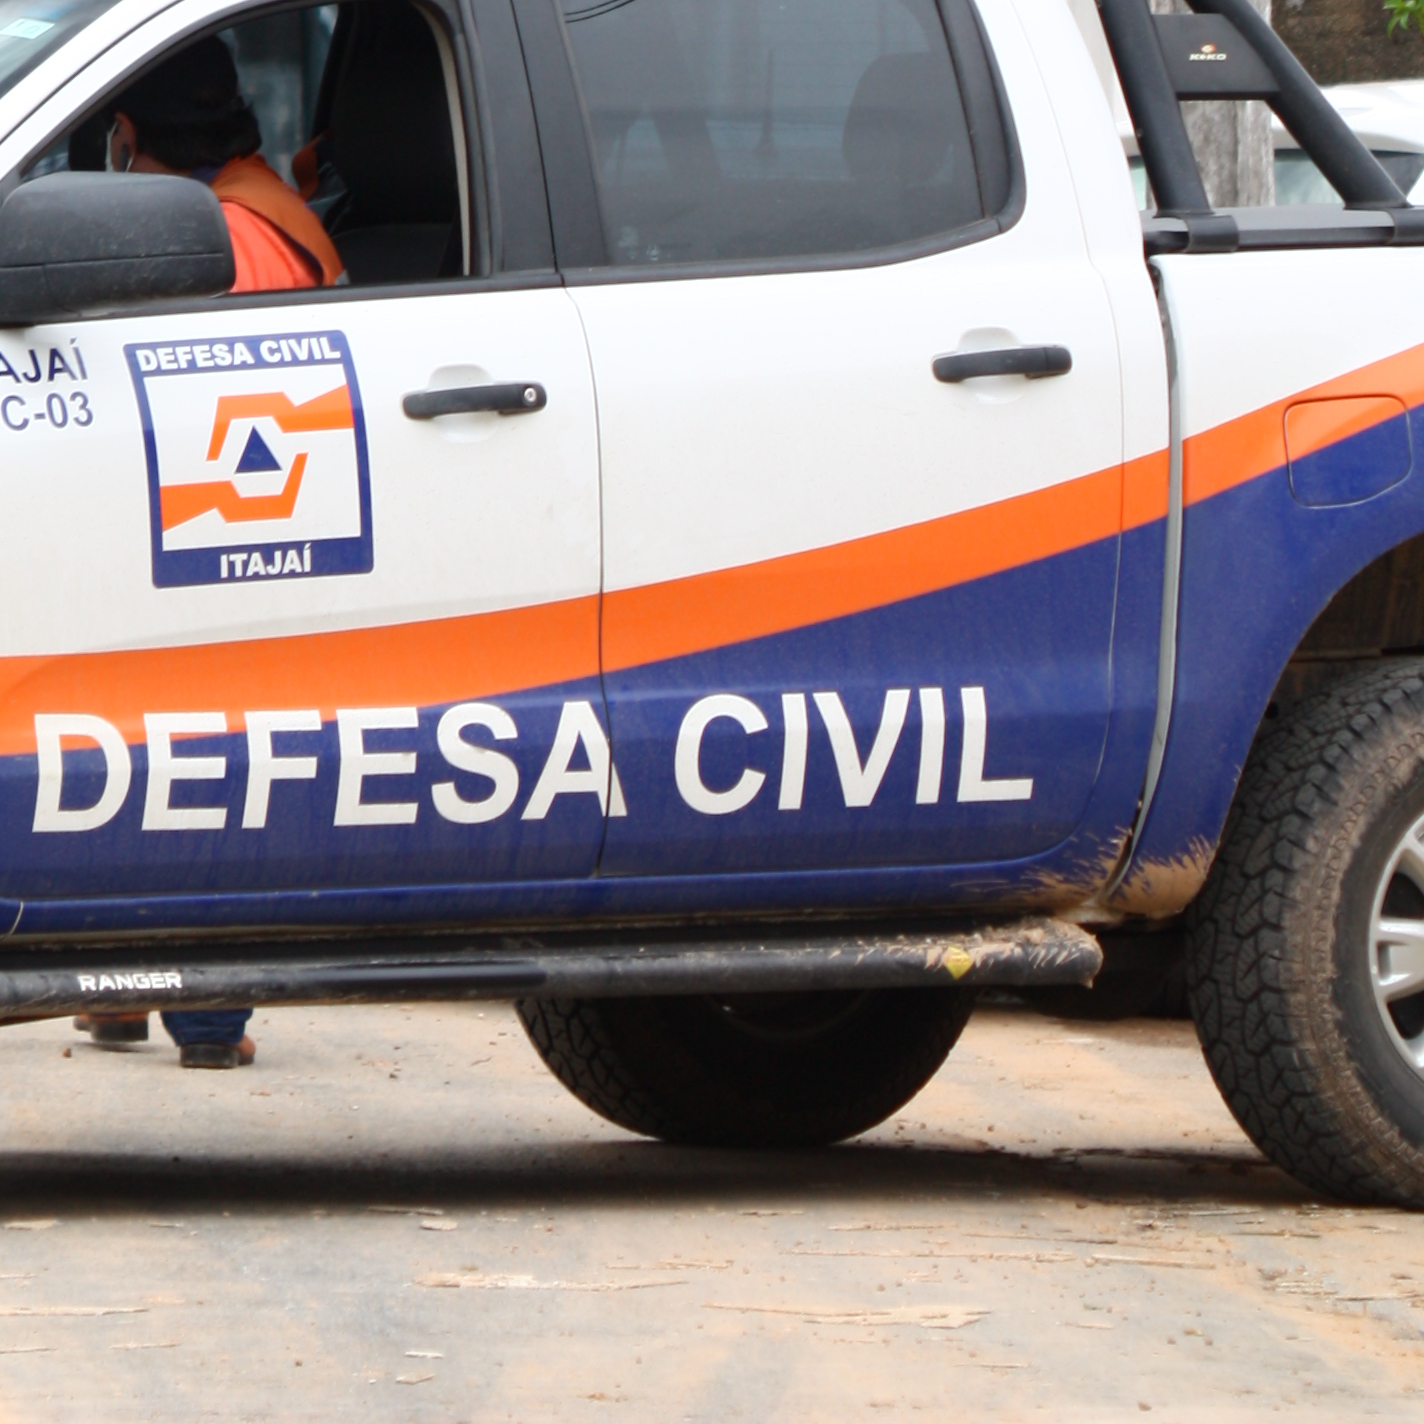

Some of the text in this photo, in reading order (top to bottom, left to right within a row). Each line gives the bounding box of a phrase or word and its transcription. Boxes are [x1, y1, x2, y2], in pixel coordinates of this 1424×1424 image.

[136, 336, 341, 372] DEFESA CIVIL
[220, 543, 312, 579] ITAJAÍ
[31, 687, 1034, 833] DEFESA CIVIL
[77, 971, 183, 992] RANGER
